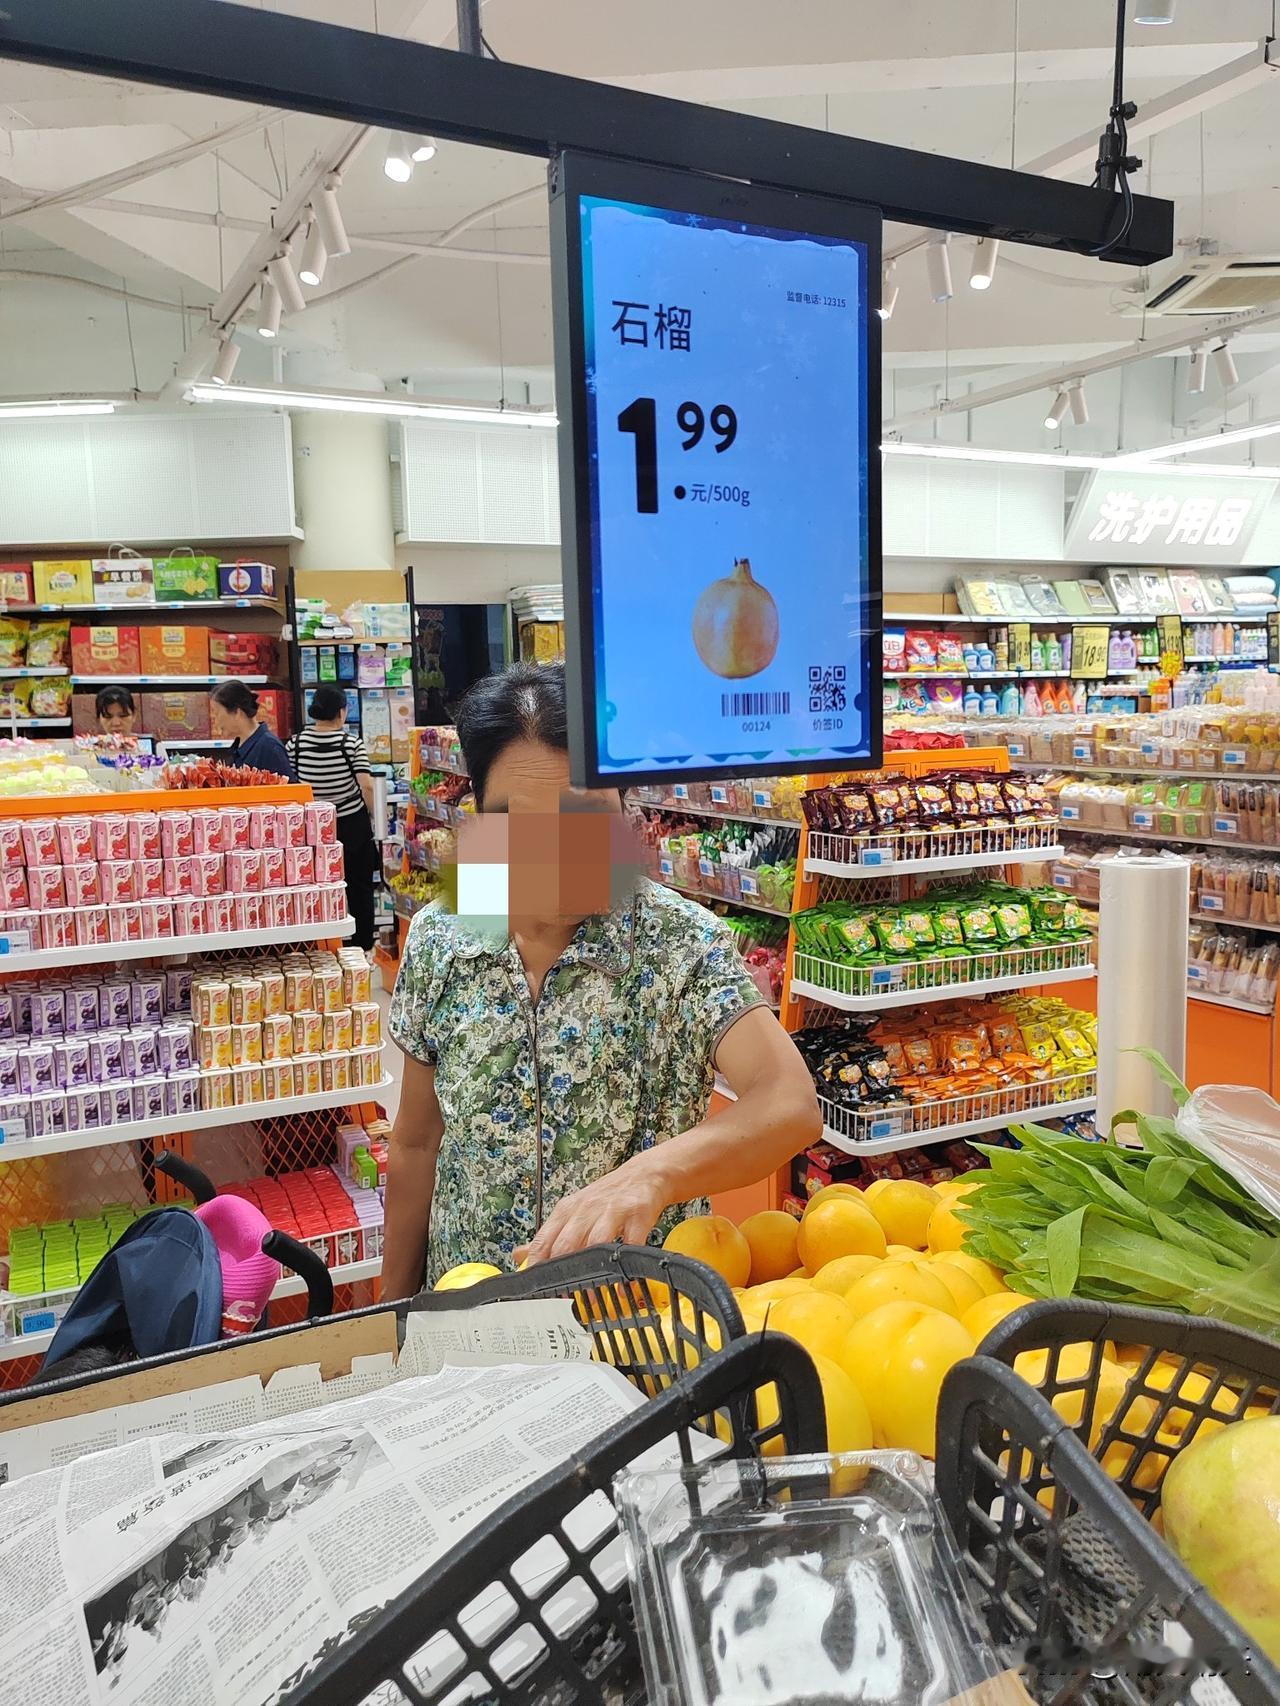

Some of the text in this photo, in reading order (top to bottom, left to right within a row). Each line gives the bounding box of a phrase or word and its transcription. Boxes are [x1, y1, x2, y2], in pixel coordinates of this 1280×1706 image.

[786, 290, 847, 308] 监督电话: 12315
[610, 299, 692, 353] 石榴
[690, 483, 751, 506] 元/500g
[1087, 489, 1253, 546] 洗护用品
[742, 721, 772, 732] 00124
[812, 718, 843, 731] 价签ID
